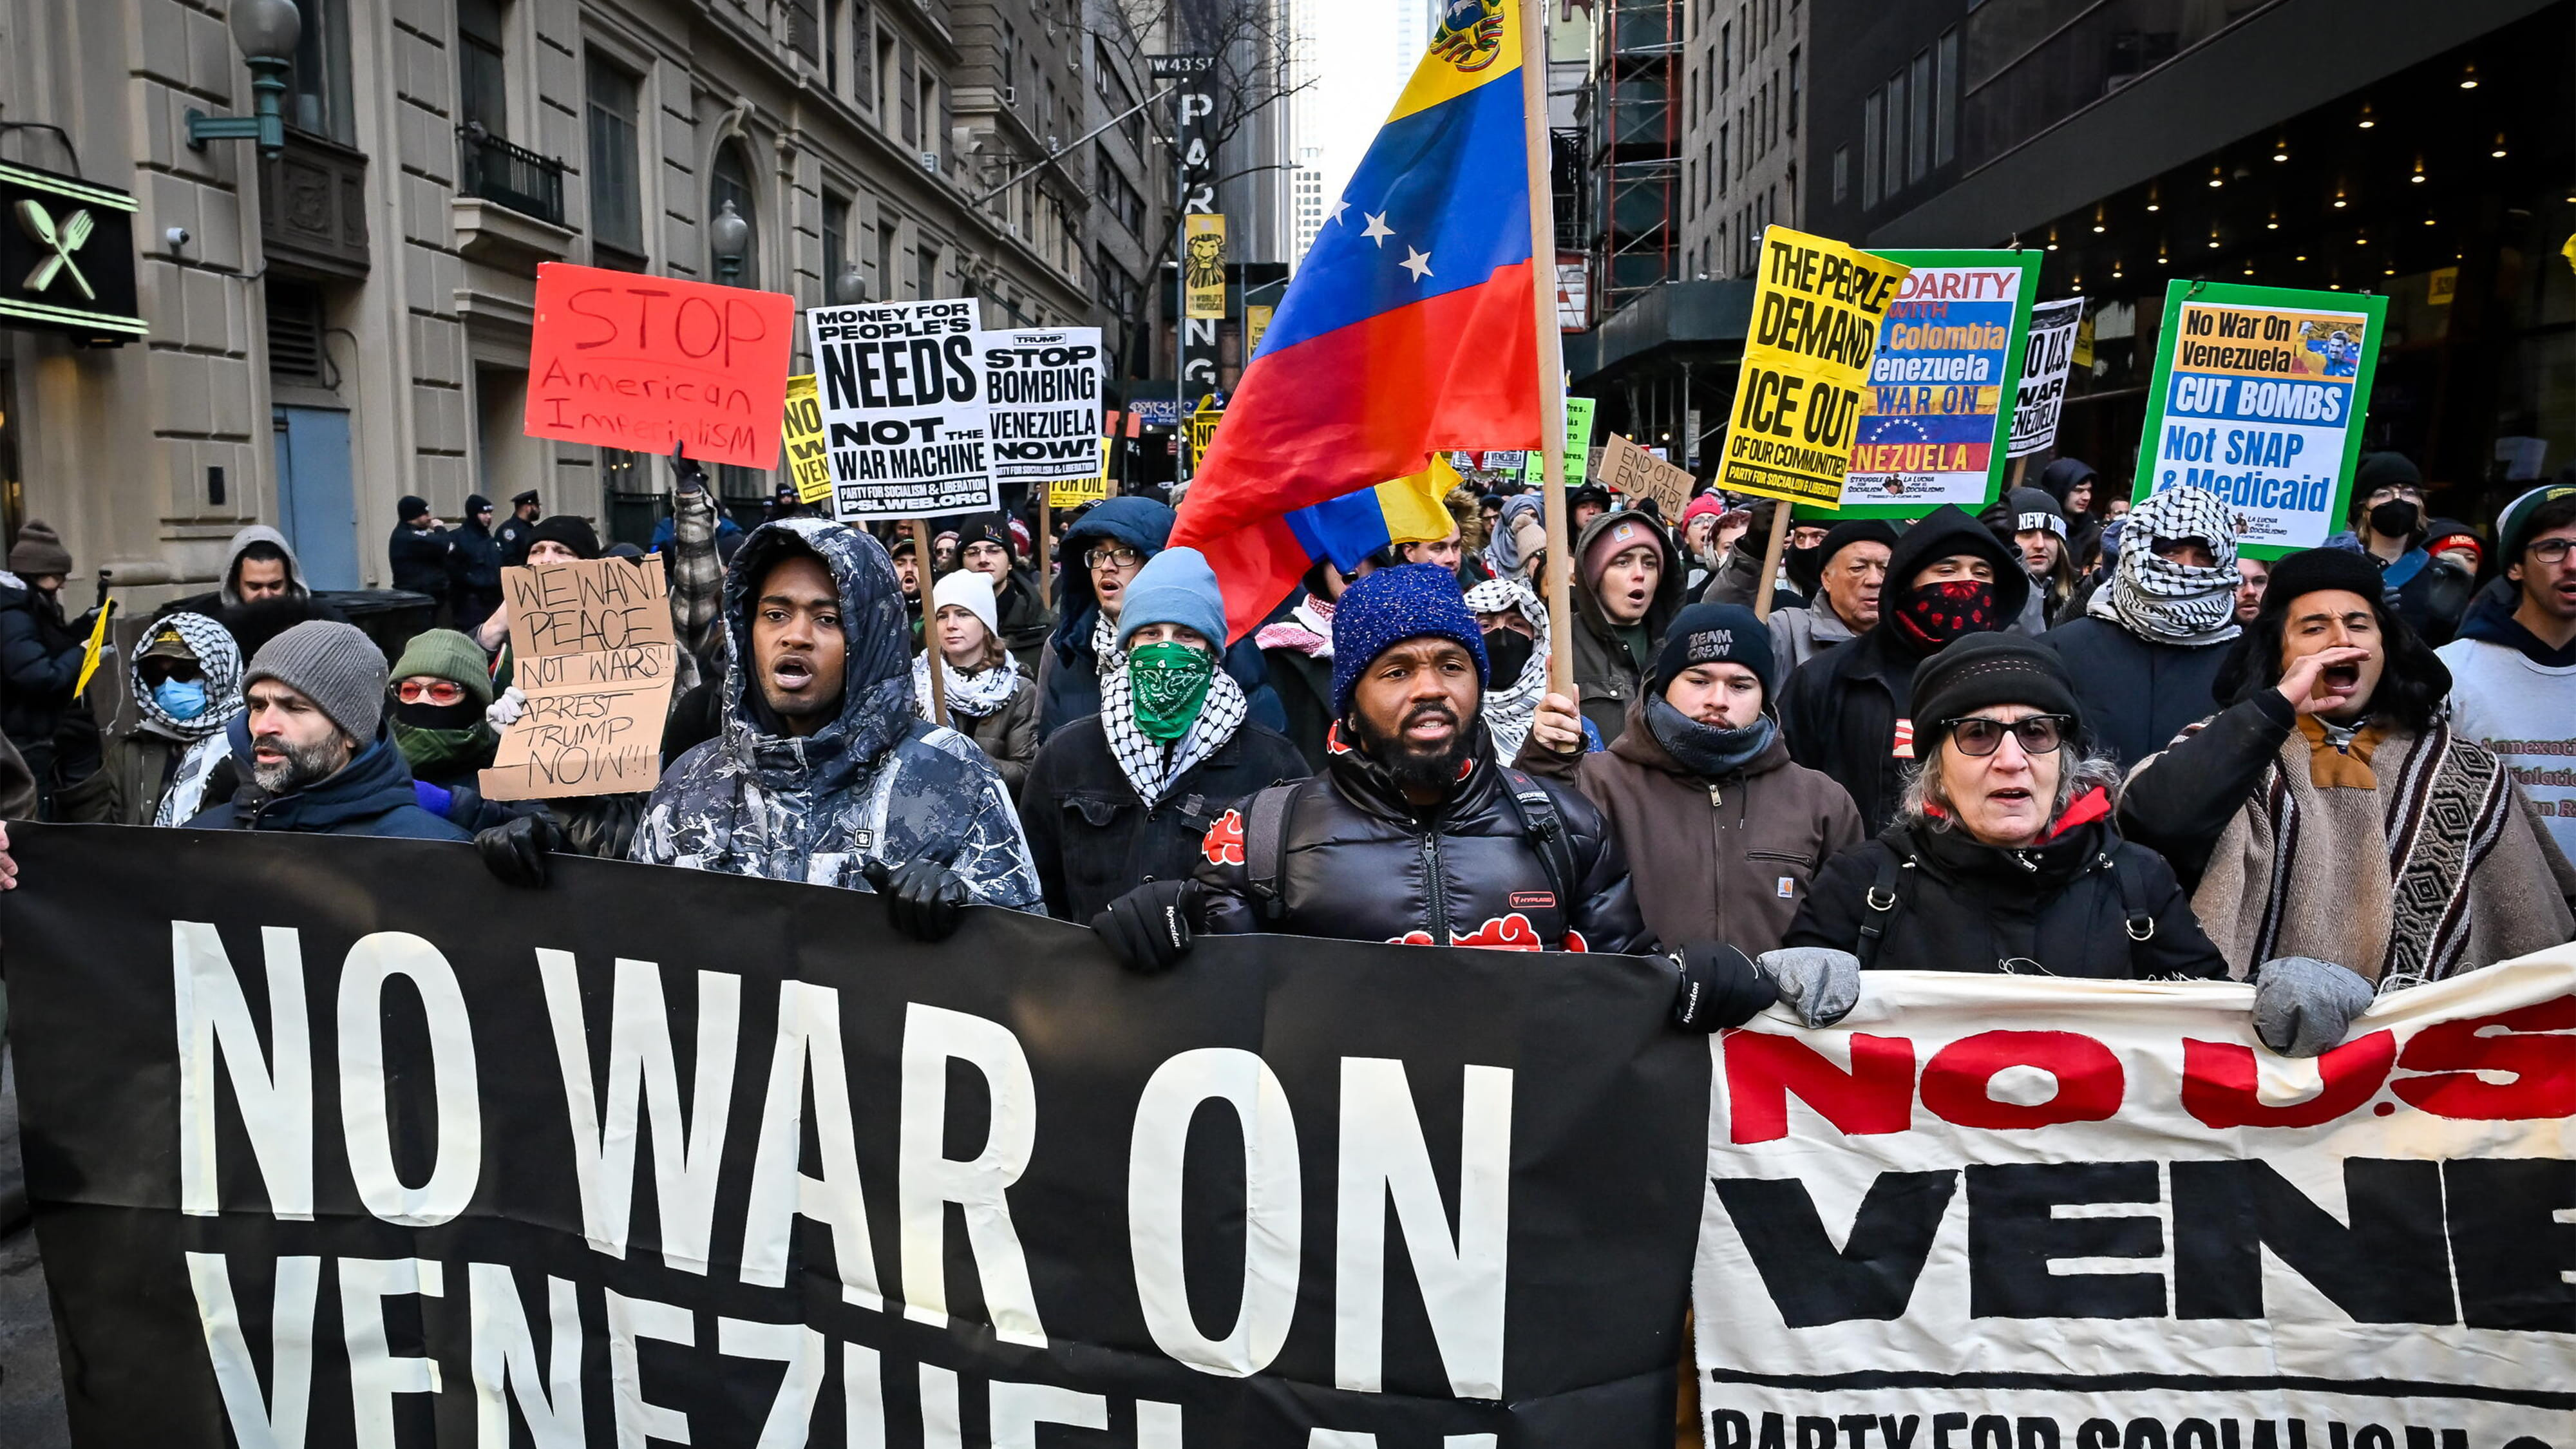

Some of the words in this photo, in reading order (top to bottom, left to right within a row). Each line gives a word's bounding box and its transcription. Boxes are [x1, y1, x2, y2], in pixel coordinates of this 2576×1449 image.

[1153, 58, 1168, 71] W
[1182, 93, 1216, 385] PARNG
[1770, 242, 1820, 294] THE
[1821, 252, 1897, 315] PEOPLE
[1895, 272, 2015, 299] DARITY
[817, 308, 911, 325] MONEY
[916, 303, 969, 317] FOR
[1888, 301, 1949, 319] WITH
[2185, 310, 2214, 336] No
[2219, 312, 2262, 340] War
[2262, 315, 2291, 341] On
[567, 287, 766, 368] STOP
[819, 318, 971, 342] PEOPLE'S
[1757, 290, 1875, 370] DEMAND
[1890, 321, 2007, 351] Colombia
[985, 346, 1096, 369] STOP
[2044, 327, 2071, 375] U.S.
[2183, 341, 2292, 373] Venezuela
[541, 356, 752, 415] American
[821, 335, 978, 410] NEEDS
[987, 366, 1095, 404] BOMBING
[1129, 401, 1193, 414] PSYCHC
[1740, 368, 1803, 437] ICE
[1803, 381, 1859, 451] OUT
[1876, 386, 1931, 414] WAR
[1942, 386, 1978, 413] ON
[2175, 376, 2231, 413] CUT
[2237, 381, 2342, 422] BOMBS
[784, 397, 823, 439] NO
[830, 417, 943, 448] NOT
[945, 428, 983, 441] THE
[990, 408, 1095, 440] VENEZUELA
[2010, 401, 2058, 437] ENEZUELA
[834, 449, 887, 481] WAR
[890, 442, 987, 478] MACHINE
[994, 438, 1096, 462] NOW!
[1732, 435, 1750, 458] OF
[1748, 439, 1774, 464] OUR
[1774, 443, 1847, 478] COMMUNITIES
[1848, 444, 1968, 471] NEZUELA
[2164, 425, 2217, 463] Not
[2224, 430, 2304, 469] SNAP
[1054, 465, 1063, 474] &
[1621, 446, 1652, 473] END
[1654, 464, 1681, 496] OIL
[1728, 466, 1753, 482] PARTY
[1752, 471, 1767, 483] FOR
[1767, 473, 1805, 491] SOCIALISM
[840, 488, 867, 500] PARTY
[867, 486, 883, 498] FOR
[884, 484, 927, 498] SOCIALISM
[928, 483, 940, 495] &
[940, 478, 987, 494] LIBERATION
[842, 491, 987, 513] PSLWEB.ORG
[1615, 465, 1644, 493] END
[1647, 481, 1681, 516] WAR!
[2158, 470, 2177, 492] &
[2186, 468, 2330, 512] Medicaid
[2018, 512, 2047, 530] NEW
[513, 566, 577, 610] WE
[575, 558, 661, 607] WANT
[520, 607, 667, 654] PEACE
[1689, 629, 1733, 648] TEAM
[1687, 643, 1730, 662] CREW
[522, 654, 583, 690] NOT
[522, 693, 634, 722] ARREST
[515, 717, 634, 748] TRUMP
[1723, 1029, 2125, 1145] NO
[172, 920, 481, 1227] NO
[535, 947, 1048, 1349] WAR
[1128, 1047, 1513, 1401] ON
[185, 1251, 1378, 1449] VENEZ
